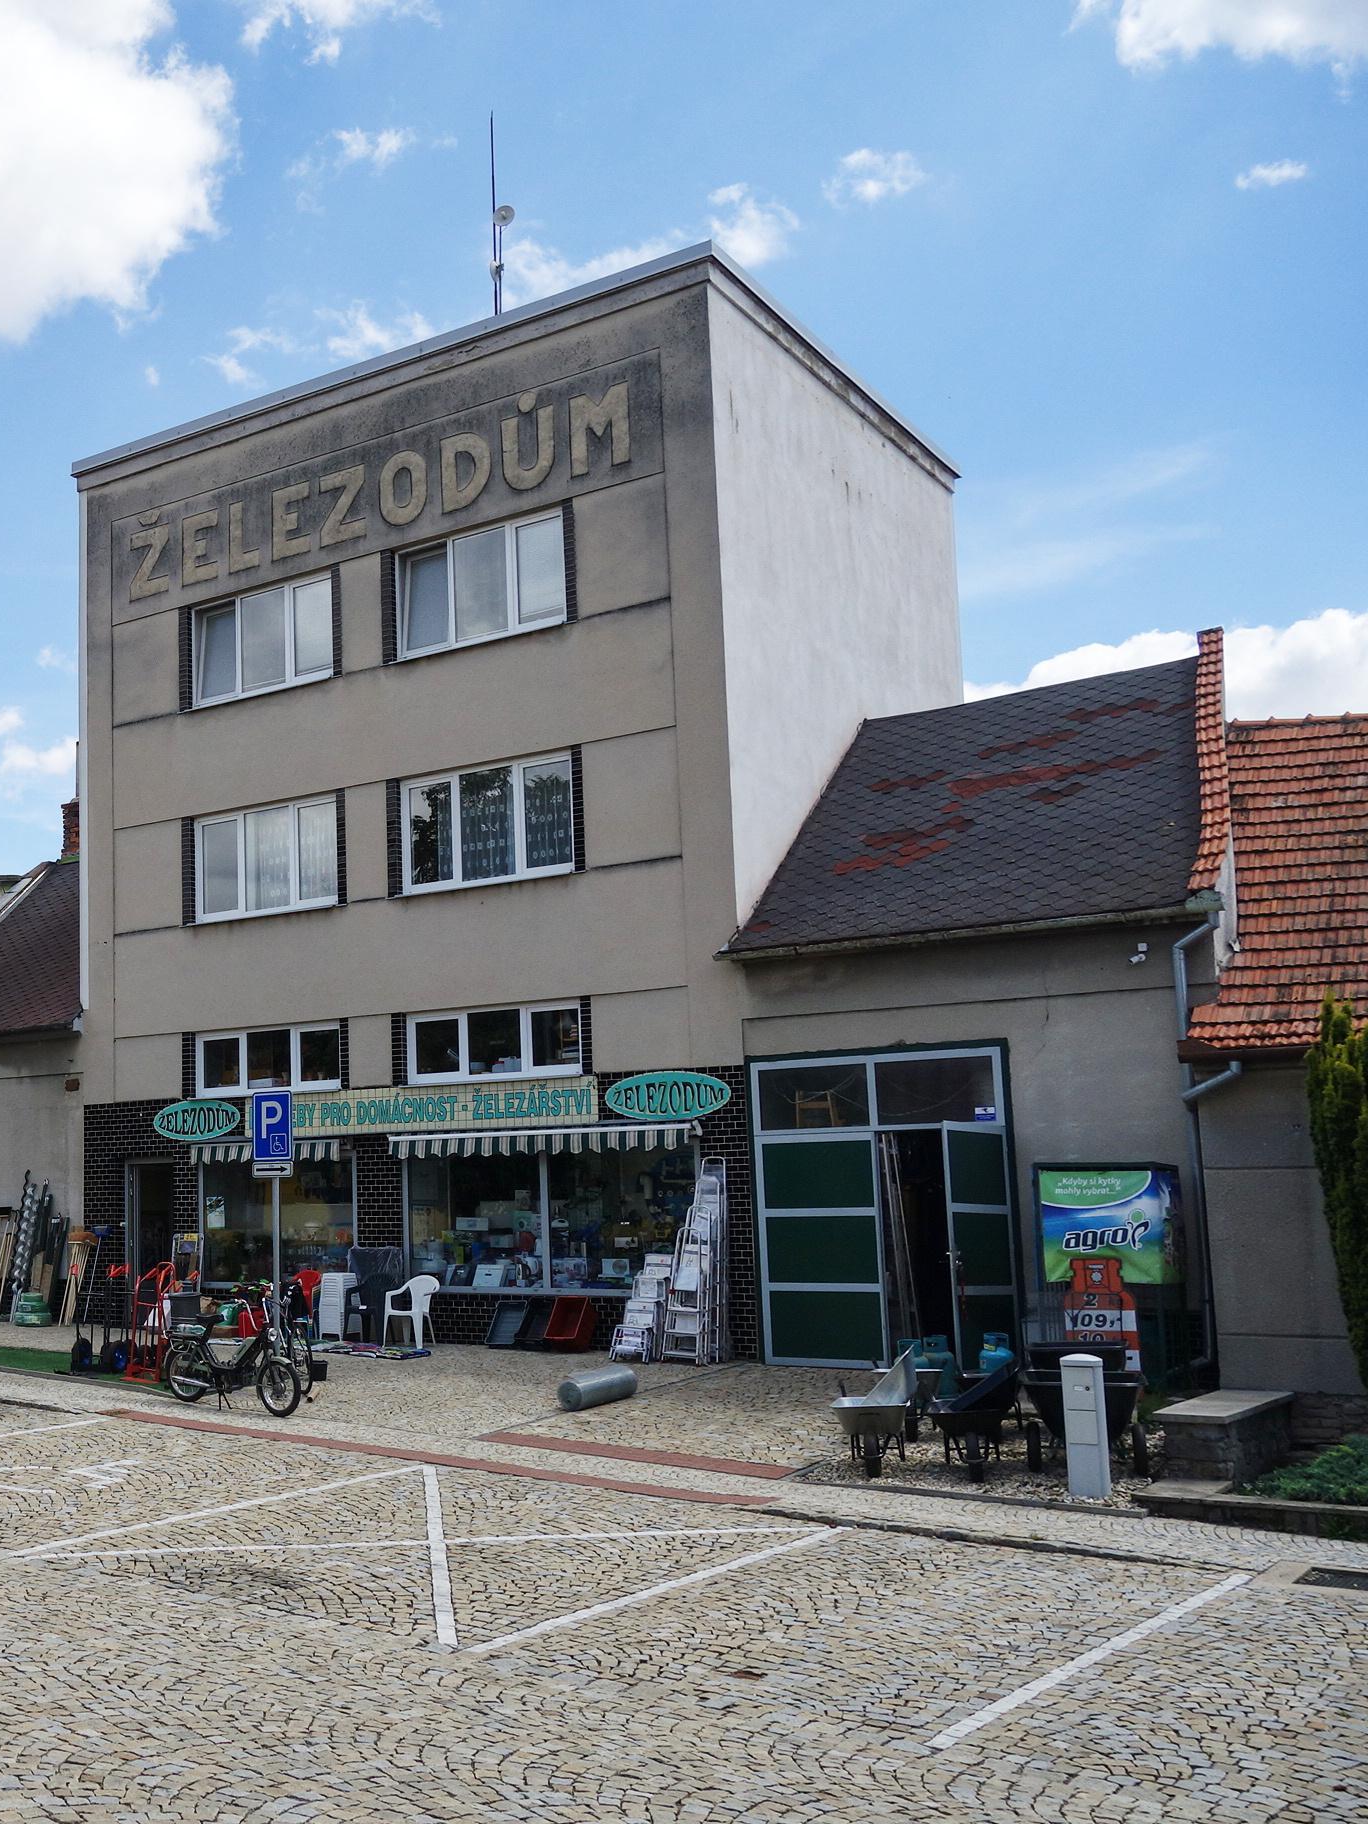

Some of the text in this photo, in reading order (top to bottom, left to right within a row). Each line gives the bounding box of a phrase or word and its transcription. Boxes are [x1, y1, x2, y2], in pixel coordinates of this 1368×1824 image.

[129, 380, 631, 602] ŽELEZODŮM
[261, 1101, 283, 1139] P
[320, 1101, 352, 1127] PRO
[356, 1092, 458, 1126] DOMÁCNOST
[472, 1081, 593, 1121] ŽELEZÁŘSTVÍ
